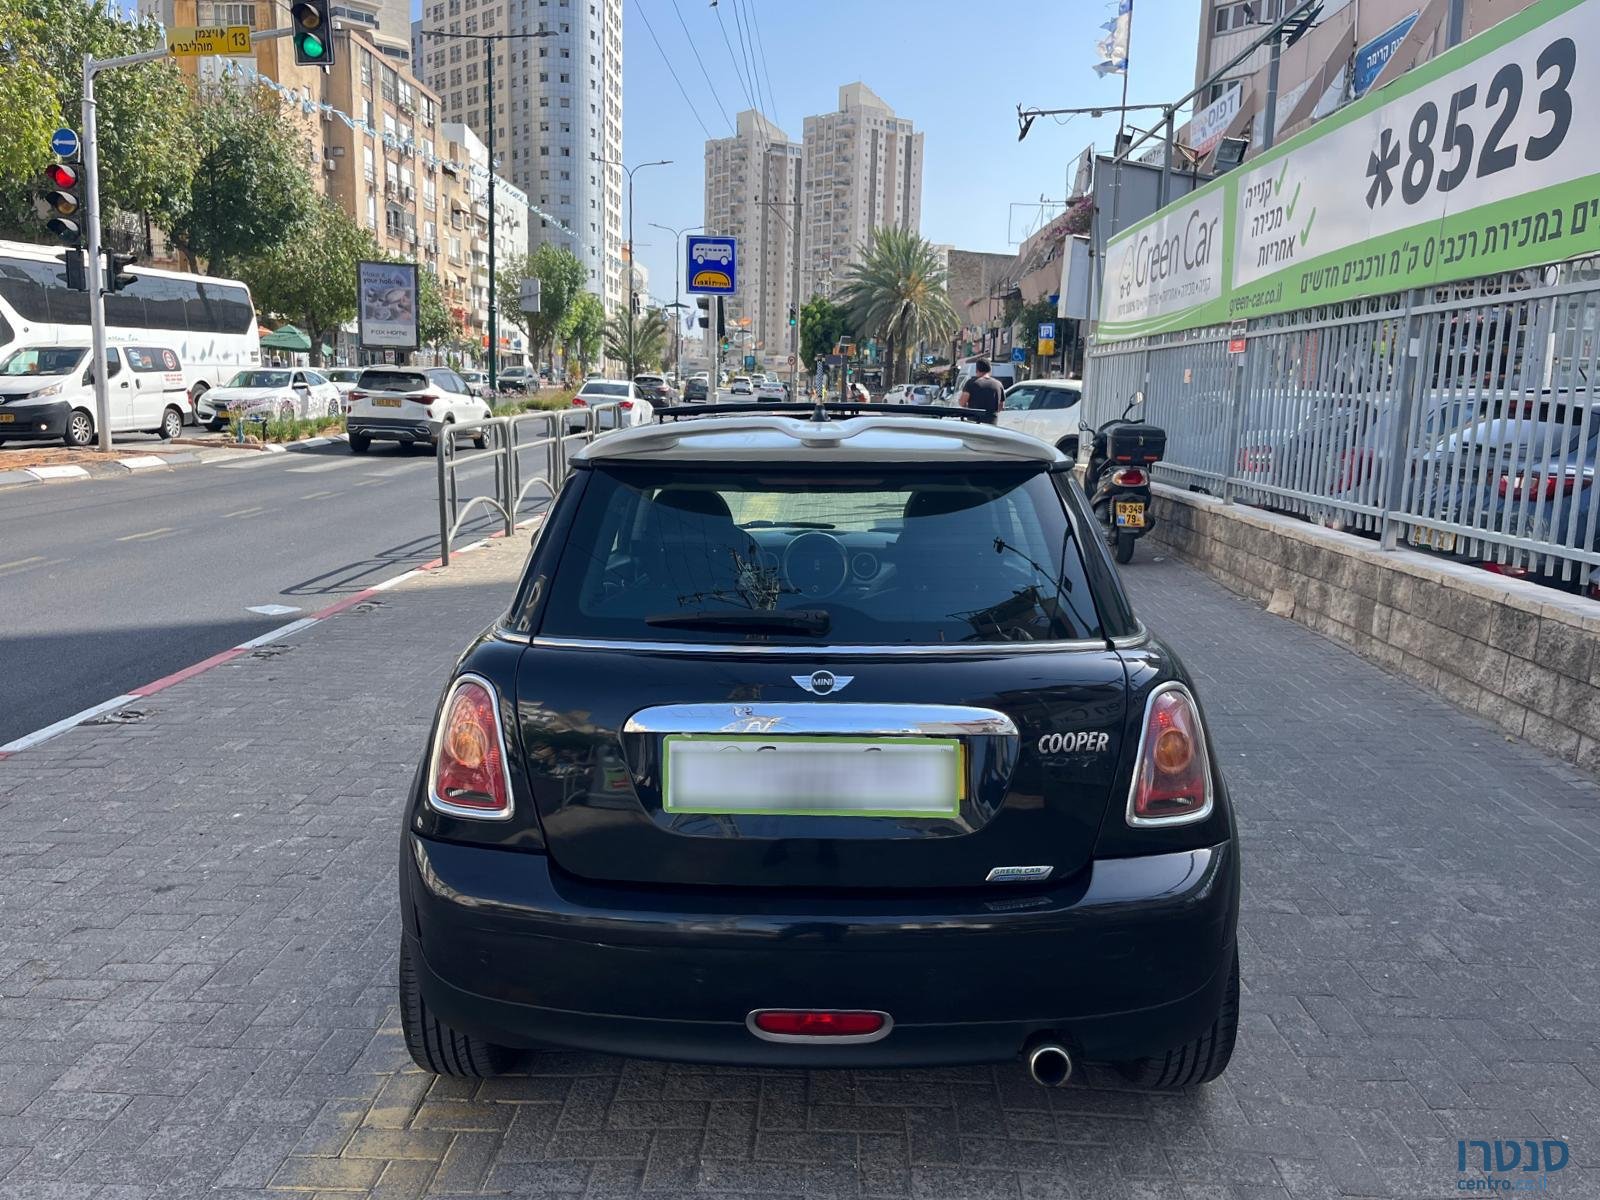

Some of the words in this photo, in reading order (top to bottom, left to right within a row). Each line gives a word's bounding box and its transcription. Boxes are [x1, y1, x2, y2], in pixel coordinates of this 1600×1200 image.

[177, 40, 213, 52] מוהליבר
[195, 29, 219, 41] ויצמן
[232, 32, 246, 46] 13
[1208, 94, 1235, 127] דפוס
[1245, 177, 1273, 208] קנייה
[1251, 206, 1283, 237] מכירה
[1481, 208, 1563, 256] במכירת
[1570, 198, 1600, 235] ים
[1136, 234, 1180, 288] Green
[1184, 209, 1218, 271] Car
[1257, 235, 1296, 268] אחריות
[1440, 231, 1477, 264] רכבי
[1300, 265, 1339, 294] חדשים
[1342, 253, 1386, 285] ורכבים
[1229, 281, 1283, 317] green-car.co.il
[1126, 514, 1137, 524] 79
[812, 678, 833, 686] MINI
[1038, 731, 1110, 754] COOPER
